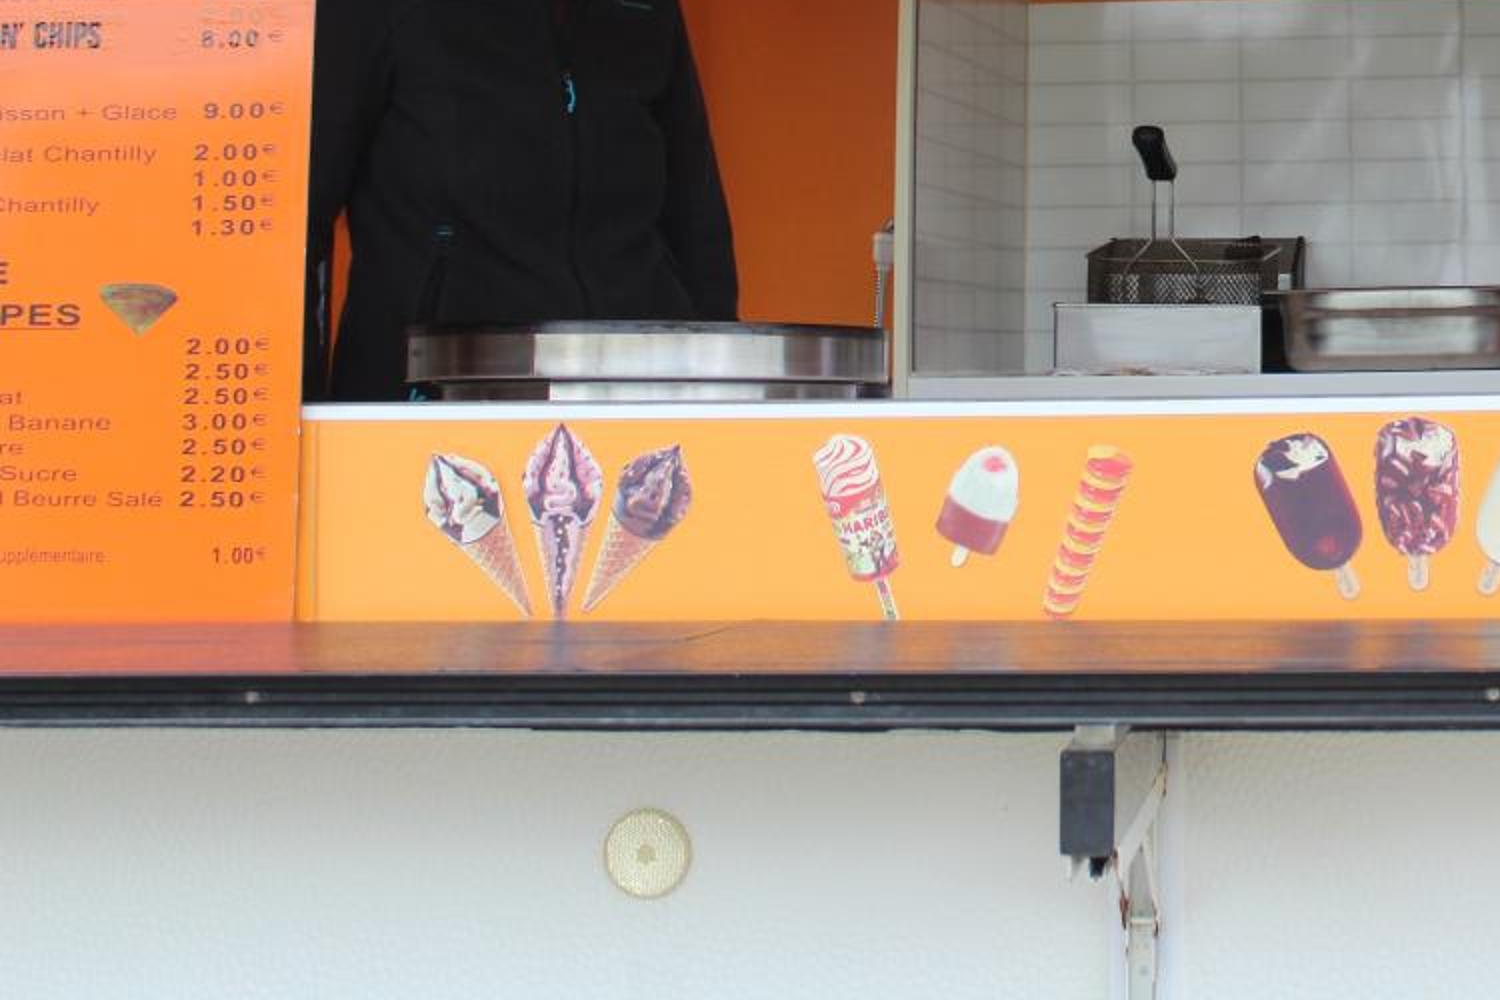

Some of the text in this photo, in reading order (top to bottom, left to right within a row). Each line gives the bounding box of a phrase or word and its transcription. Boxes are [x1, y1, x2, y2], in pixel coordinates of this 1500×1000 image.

[34, 21, 102, 49] CHIPS
[101, 104, 177, 121] Glace
[203, 103, 284, 119] 9.00€
[44, 145, 157, 166] Chantilly
[194, 144, 277, 161] 2.00€
[194, 170, 278, 188] 1.00€
[192, 195, 273, 212] 1.50€
[191, 220, 272, 236] 1.30€
[186, 337, 269, 355] 2.00€
[185, 363, 267, 380] 2.50€
[183, 387, 267, 405] 2.50€
[9, 413, 266, 431] Banane 3.00€
[181, 438, 265, 455] 2.50€
[0, 465, 264, 483] Sucre 2.20€
[14, 489, 96, 507] Beurre
[107, 489, 161, 507] Salé
[179, 491, 264, 508] 2.50€
